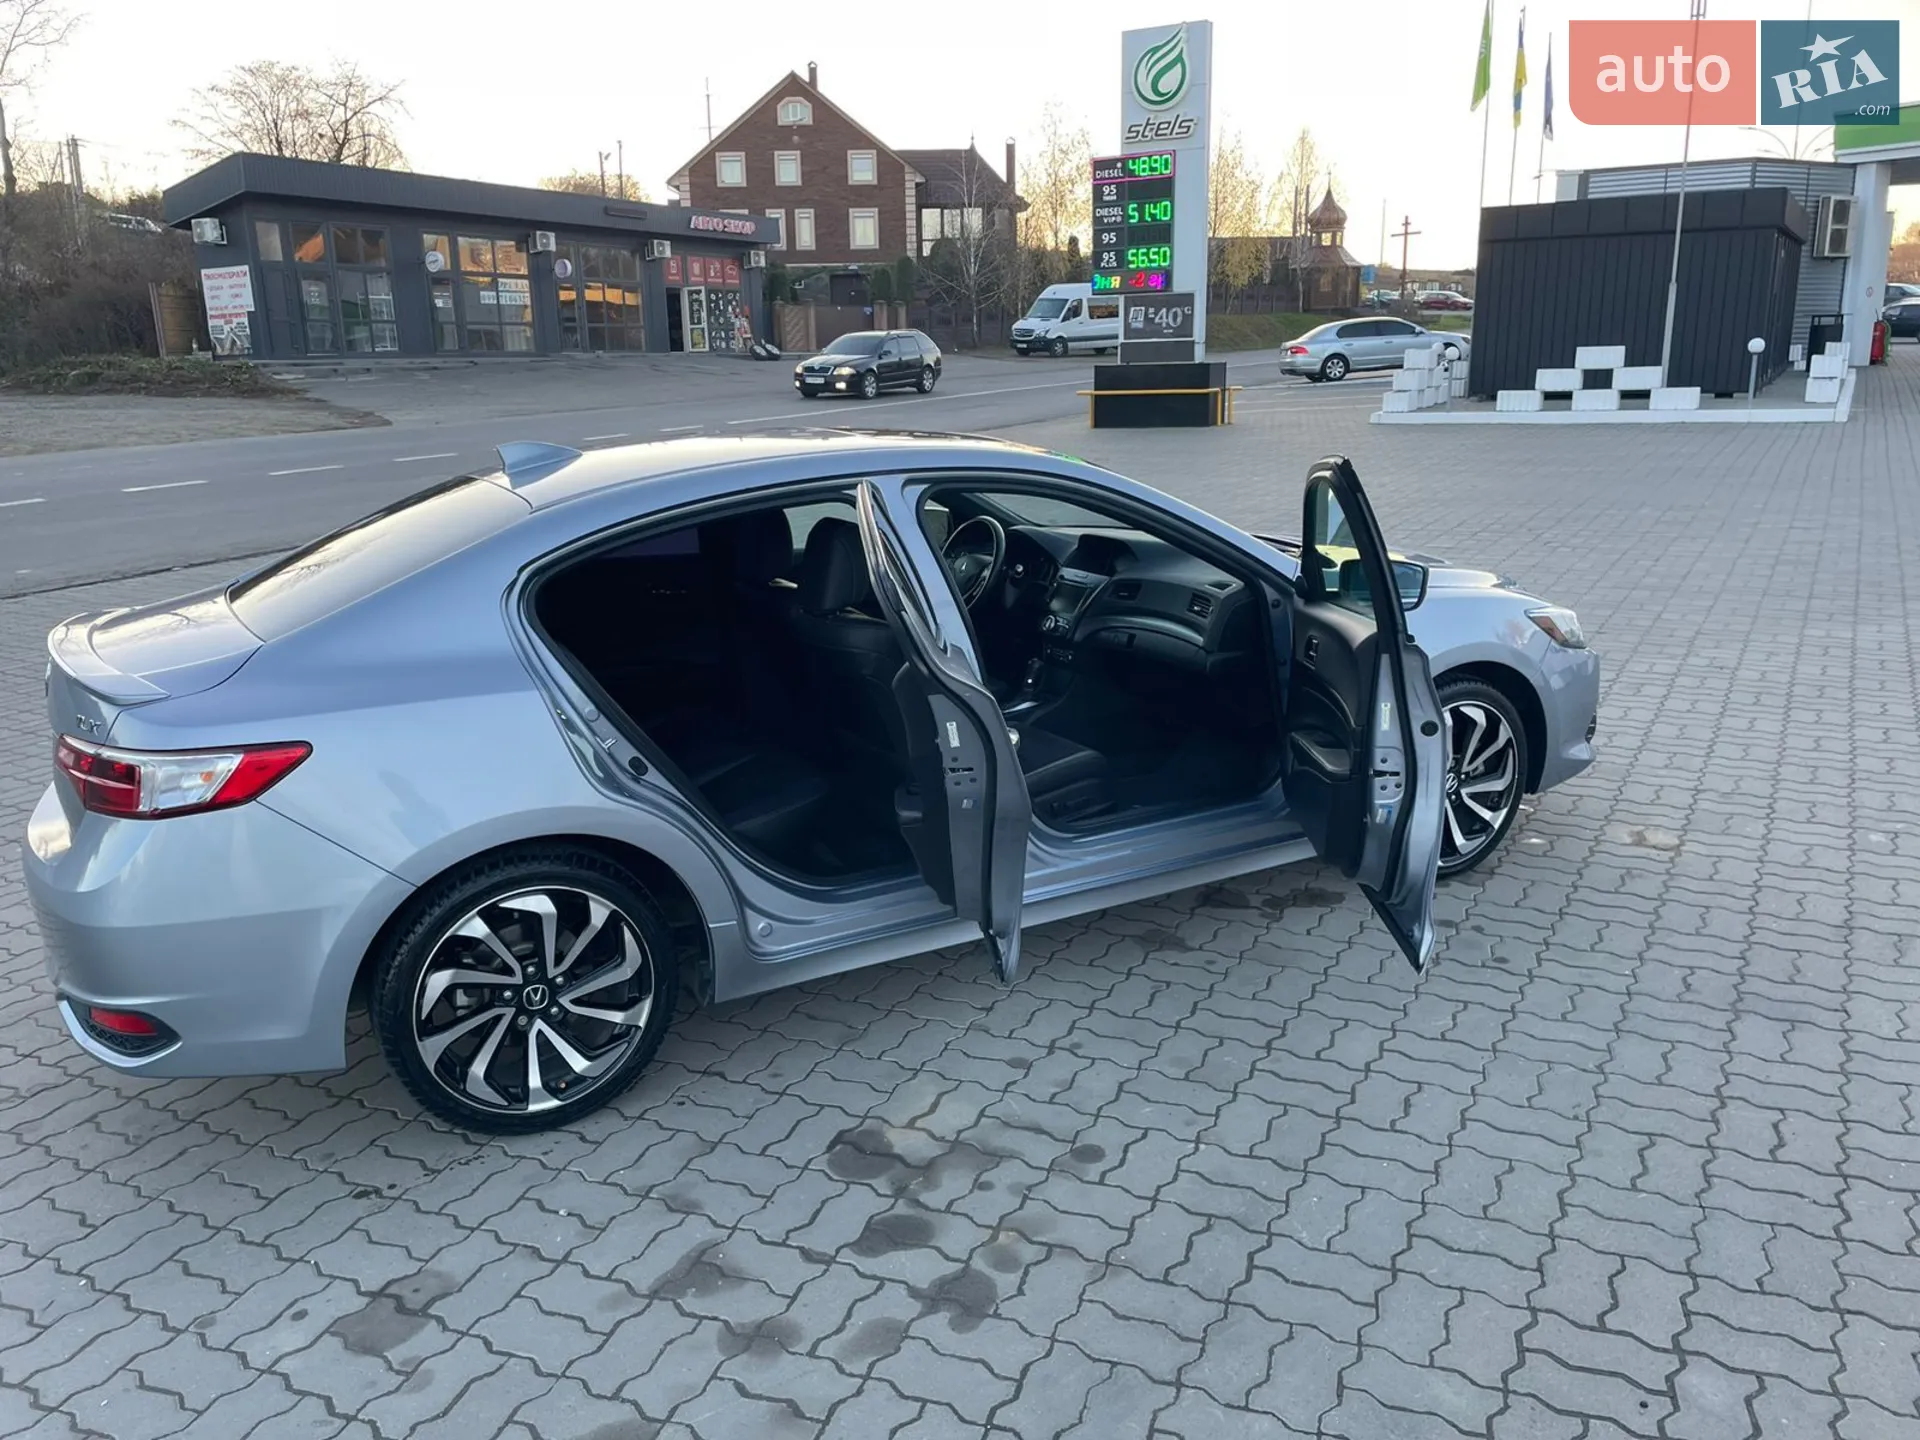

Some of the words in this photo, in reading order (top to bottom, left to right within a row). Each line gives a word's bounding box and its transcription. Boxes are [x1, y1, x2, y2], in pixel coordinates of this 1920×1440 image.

[1125, 114, 1195, 140] stels
[1095, 168, 1124, 179] DIESEL
[1102, 184, 1117, 196] 95
[1095, 206, 1124, 217] DIESEL
[1101, 232, 1117, 244] 95
[1102, 251, 1116, 263] 95
